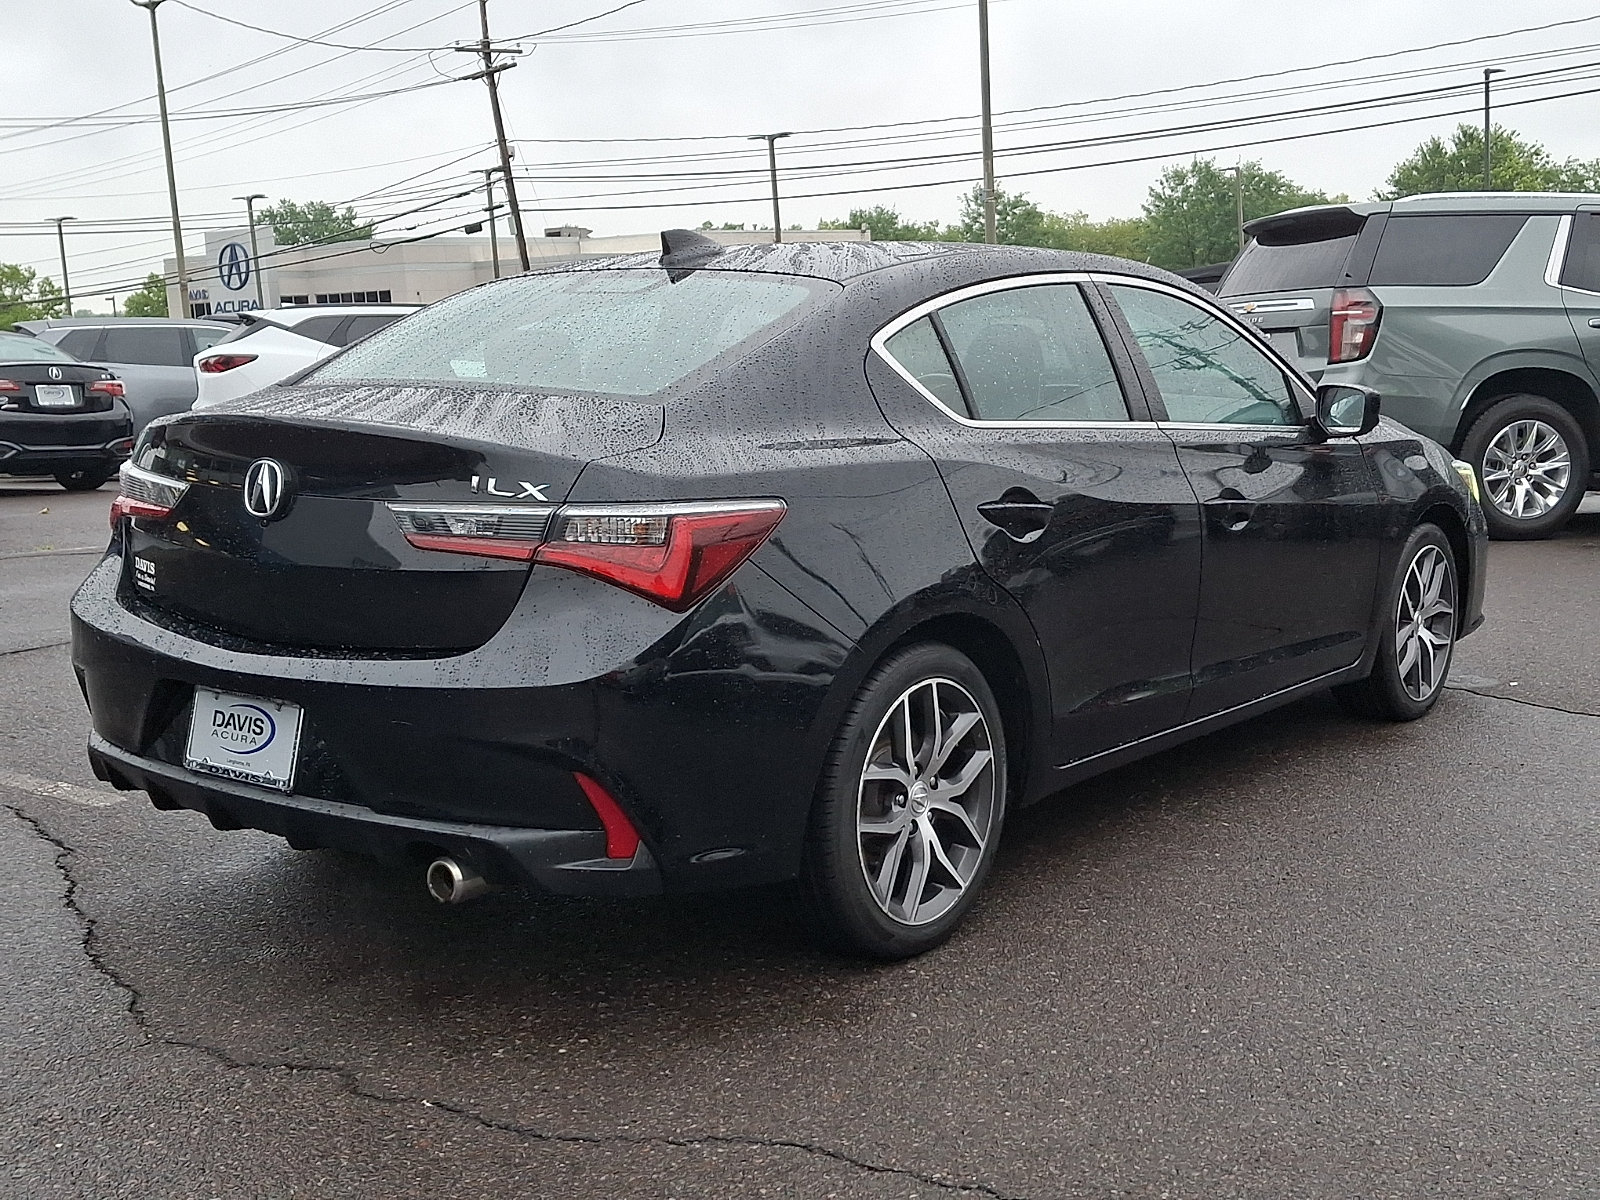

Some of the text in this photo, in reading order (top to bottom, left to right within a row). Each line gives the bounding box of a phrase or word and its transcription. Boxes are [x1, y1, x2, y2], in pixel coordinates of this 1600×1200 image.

[214, 299, 259, 314] ACURA
[471, 475, 550, 502] ILX
[135, 556, 156, 575] DAVIS
[212, 709, 265, 736] DAVIS
[211, 729, 258, 746] ACURA
